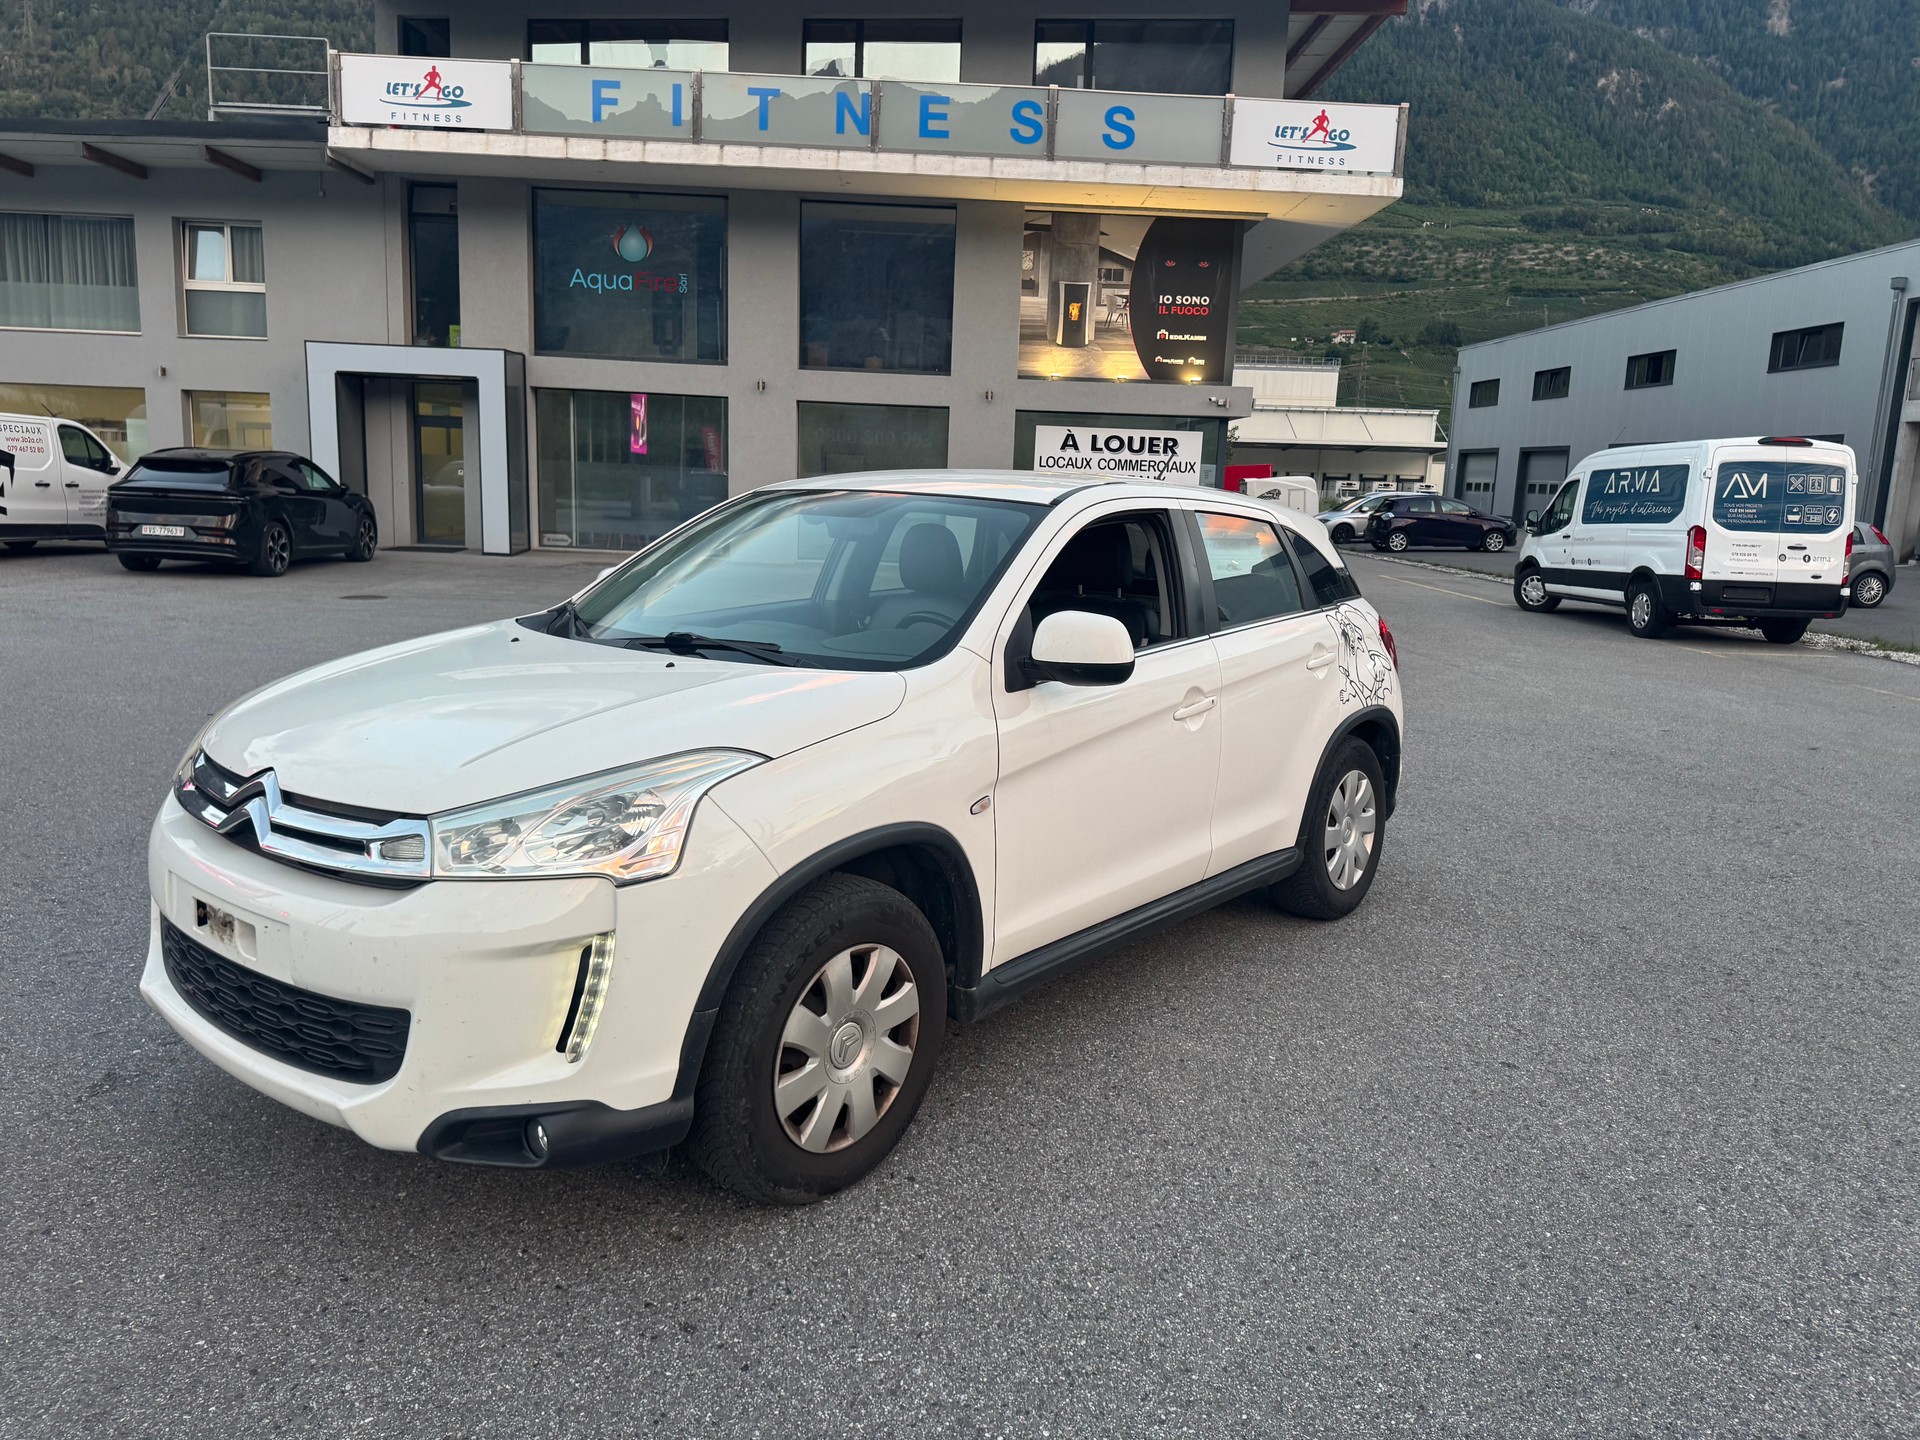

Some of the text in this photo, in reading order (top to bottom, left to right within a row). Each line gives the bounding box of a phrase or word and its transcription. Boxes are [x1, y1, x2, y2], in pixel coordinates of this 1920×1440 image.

[385, 82, 465, 99] LET'S GO
[390, 111, 462, 123] FITNESS
[592, 79, 1137, 151] FITNESS
[1274, 125, 1350, 142] LET'S GO
[1276, 154, 1346, 166] FITNESS
[1158, 294, 1210, 306] IO SONO
[1158, 305, 1210, 316] IL FUOCO
[7, 444, 18, 452] 079
[1059, 428, 1180, 457] À LOUER
[1038, 455, 1197, 474] LOCAUX COMMERCIAUX
[1603, 469, 1661, 494] ARMA
[1589, 499, 1603, 519] Vos
[1602, 501, 1630, 522] projets
[770, 918, 846, 1006] NEXEN
